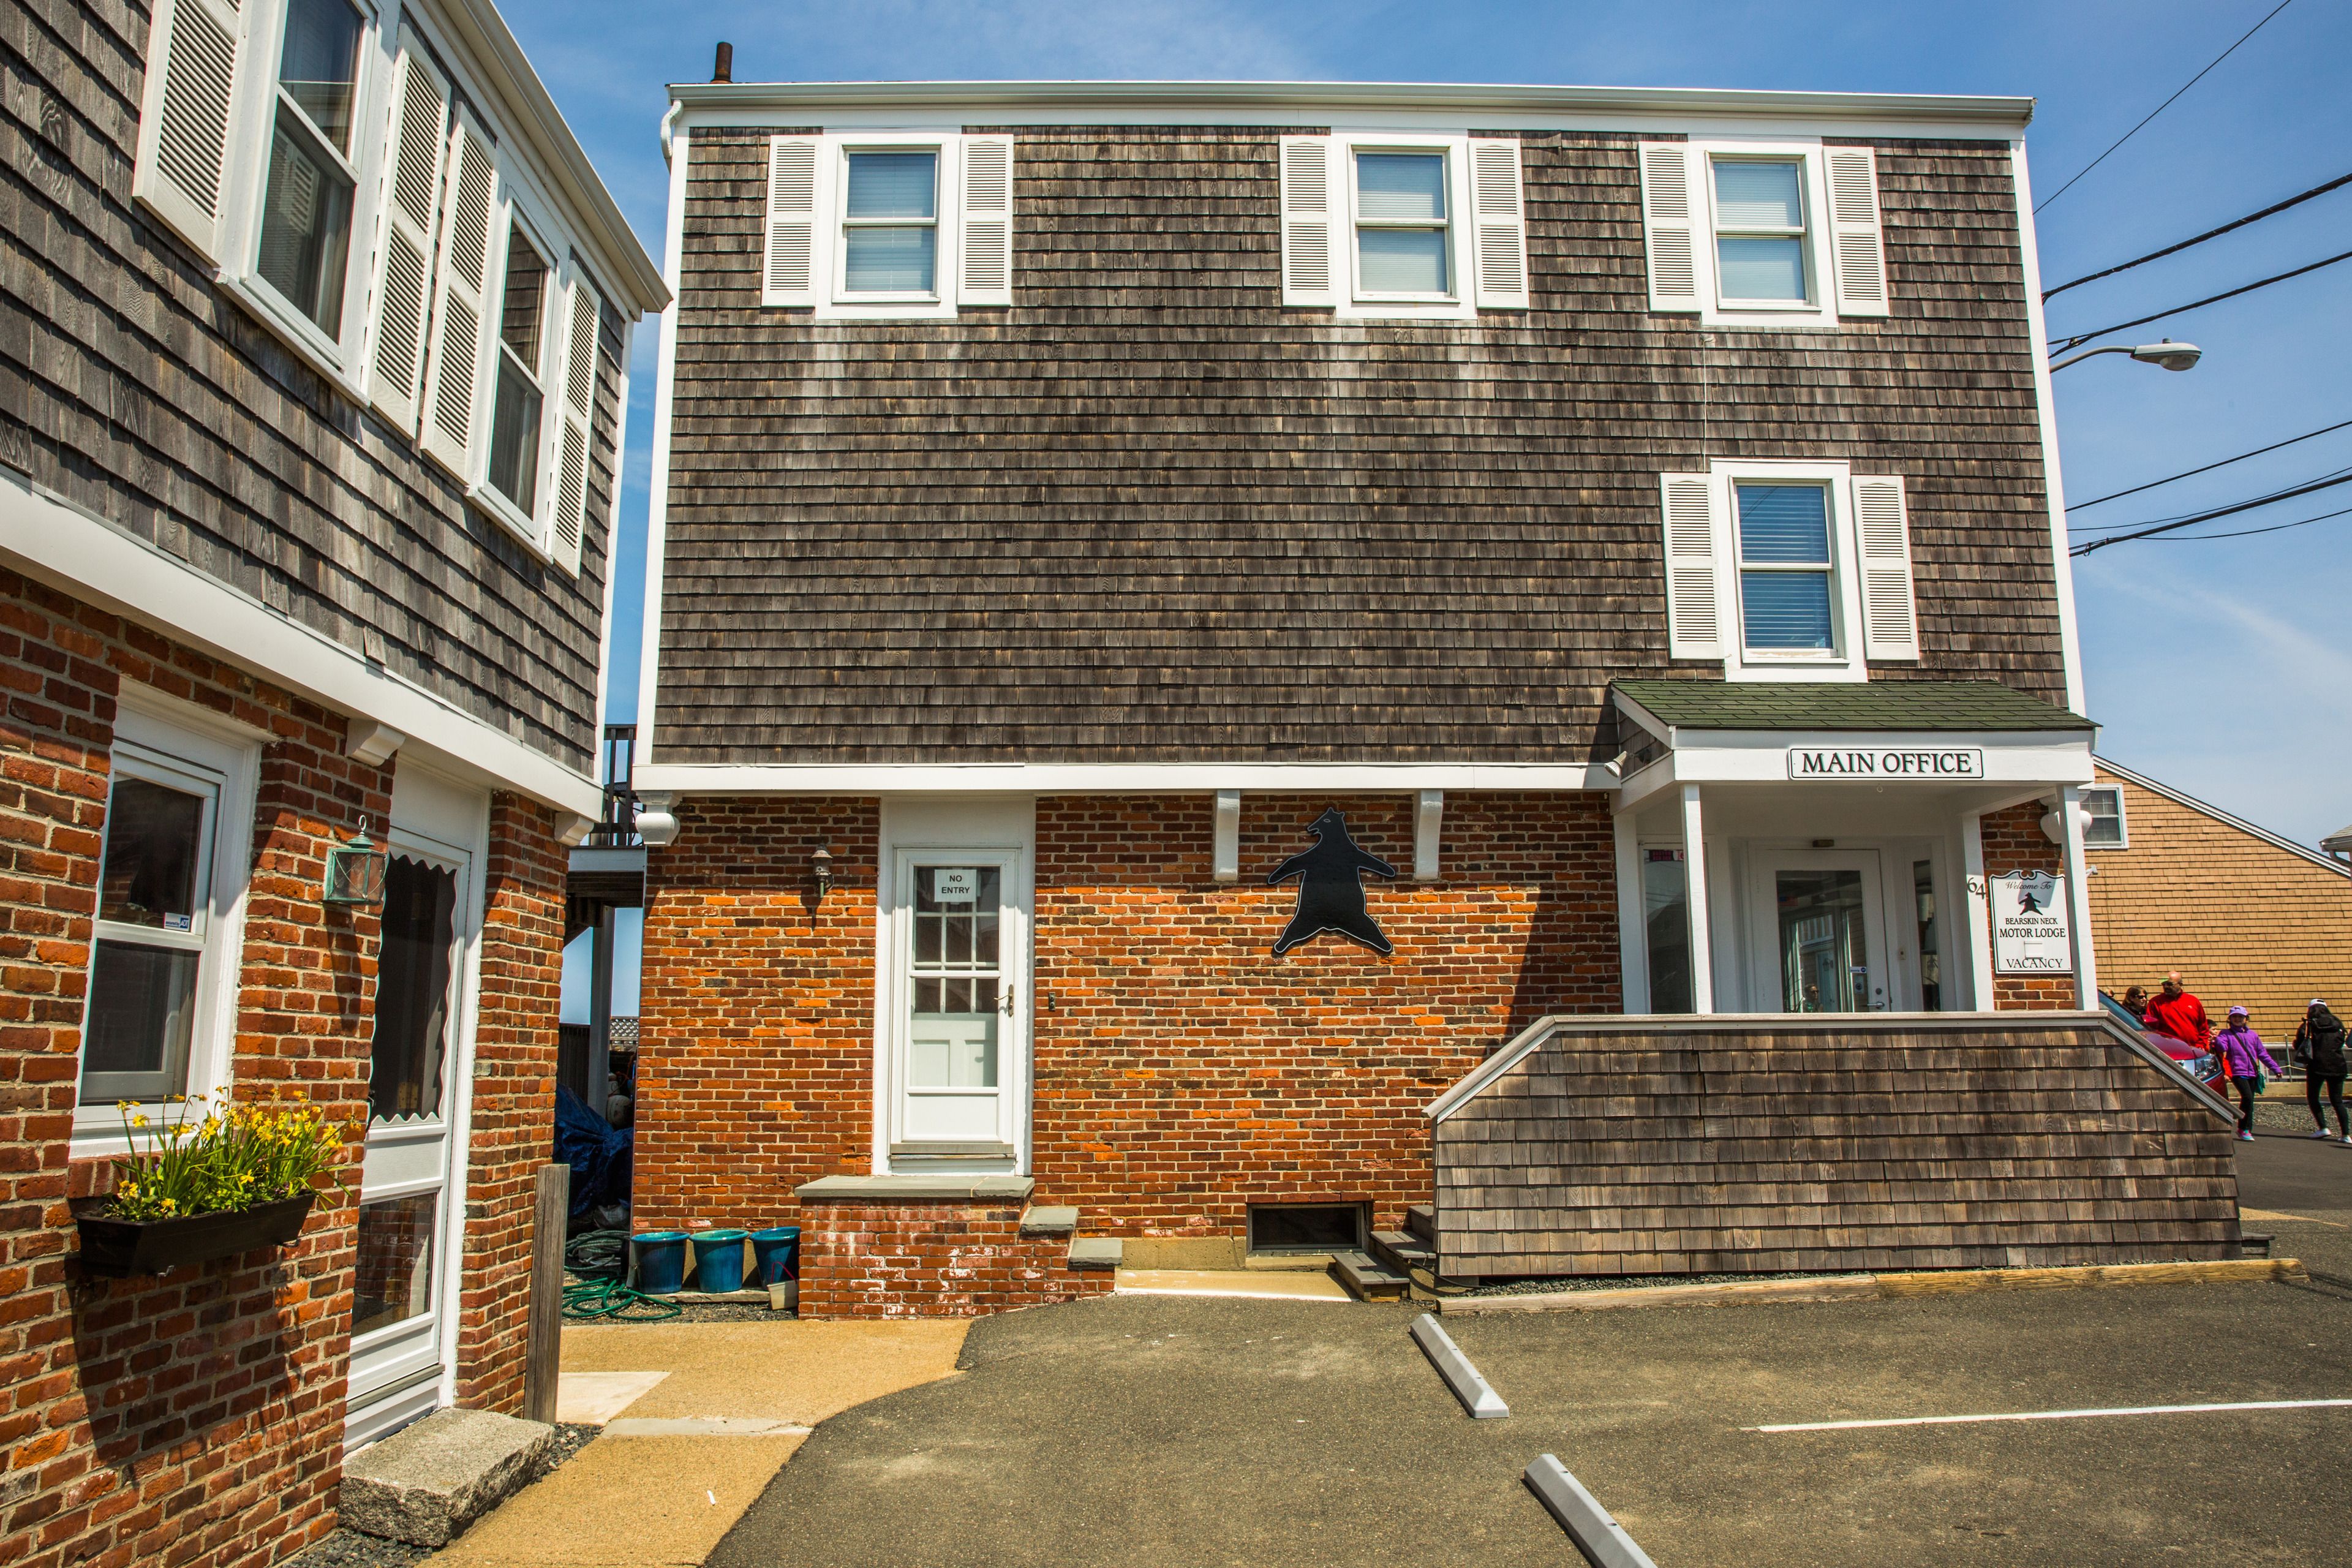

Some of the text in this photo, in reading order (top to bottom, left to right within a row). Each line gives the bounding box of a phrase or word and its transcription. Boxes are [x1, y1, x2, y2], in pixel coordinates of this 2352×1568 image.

[1801, 752, 1972, 773] MAIN OFFICE
[1967, 877, 1986, 900] 64
[2005, 881, 2052, 890] Welcome To
[1999, 928, 2066, 938] MOTOR LODGE
[2006, 958, 2064, 968] VACANCY
